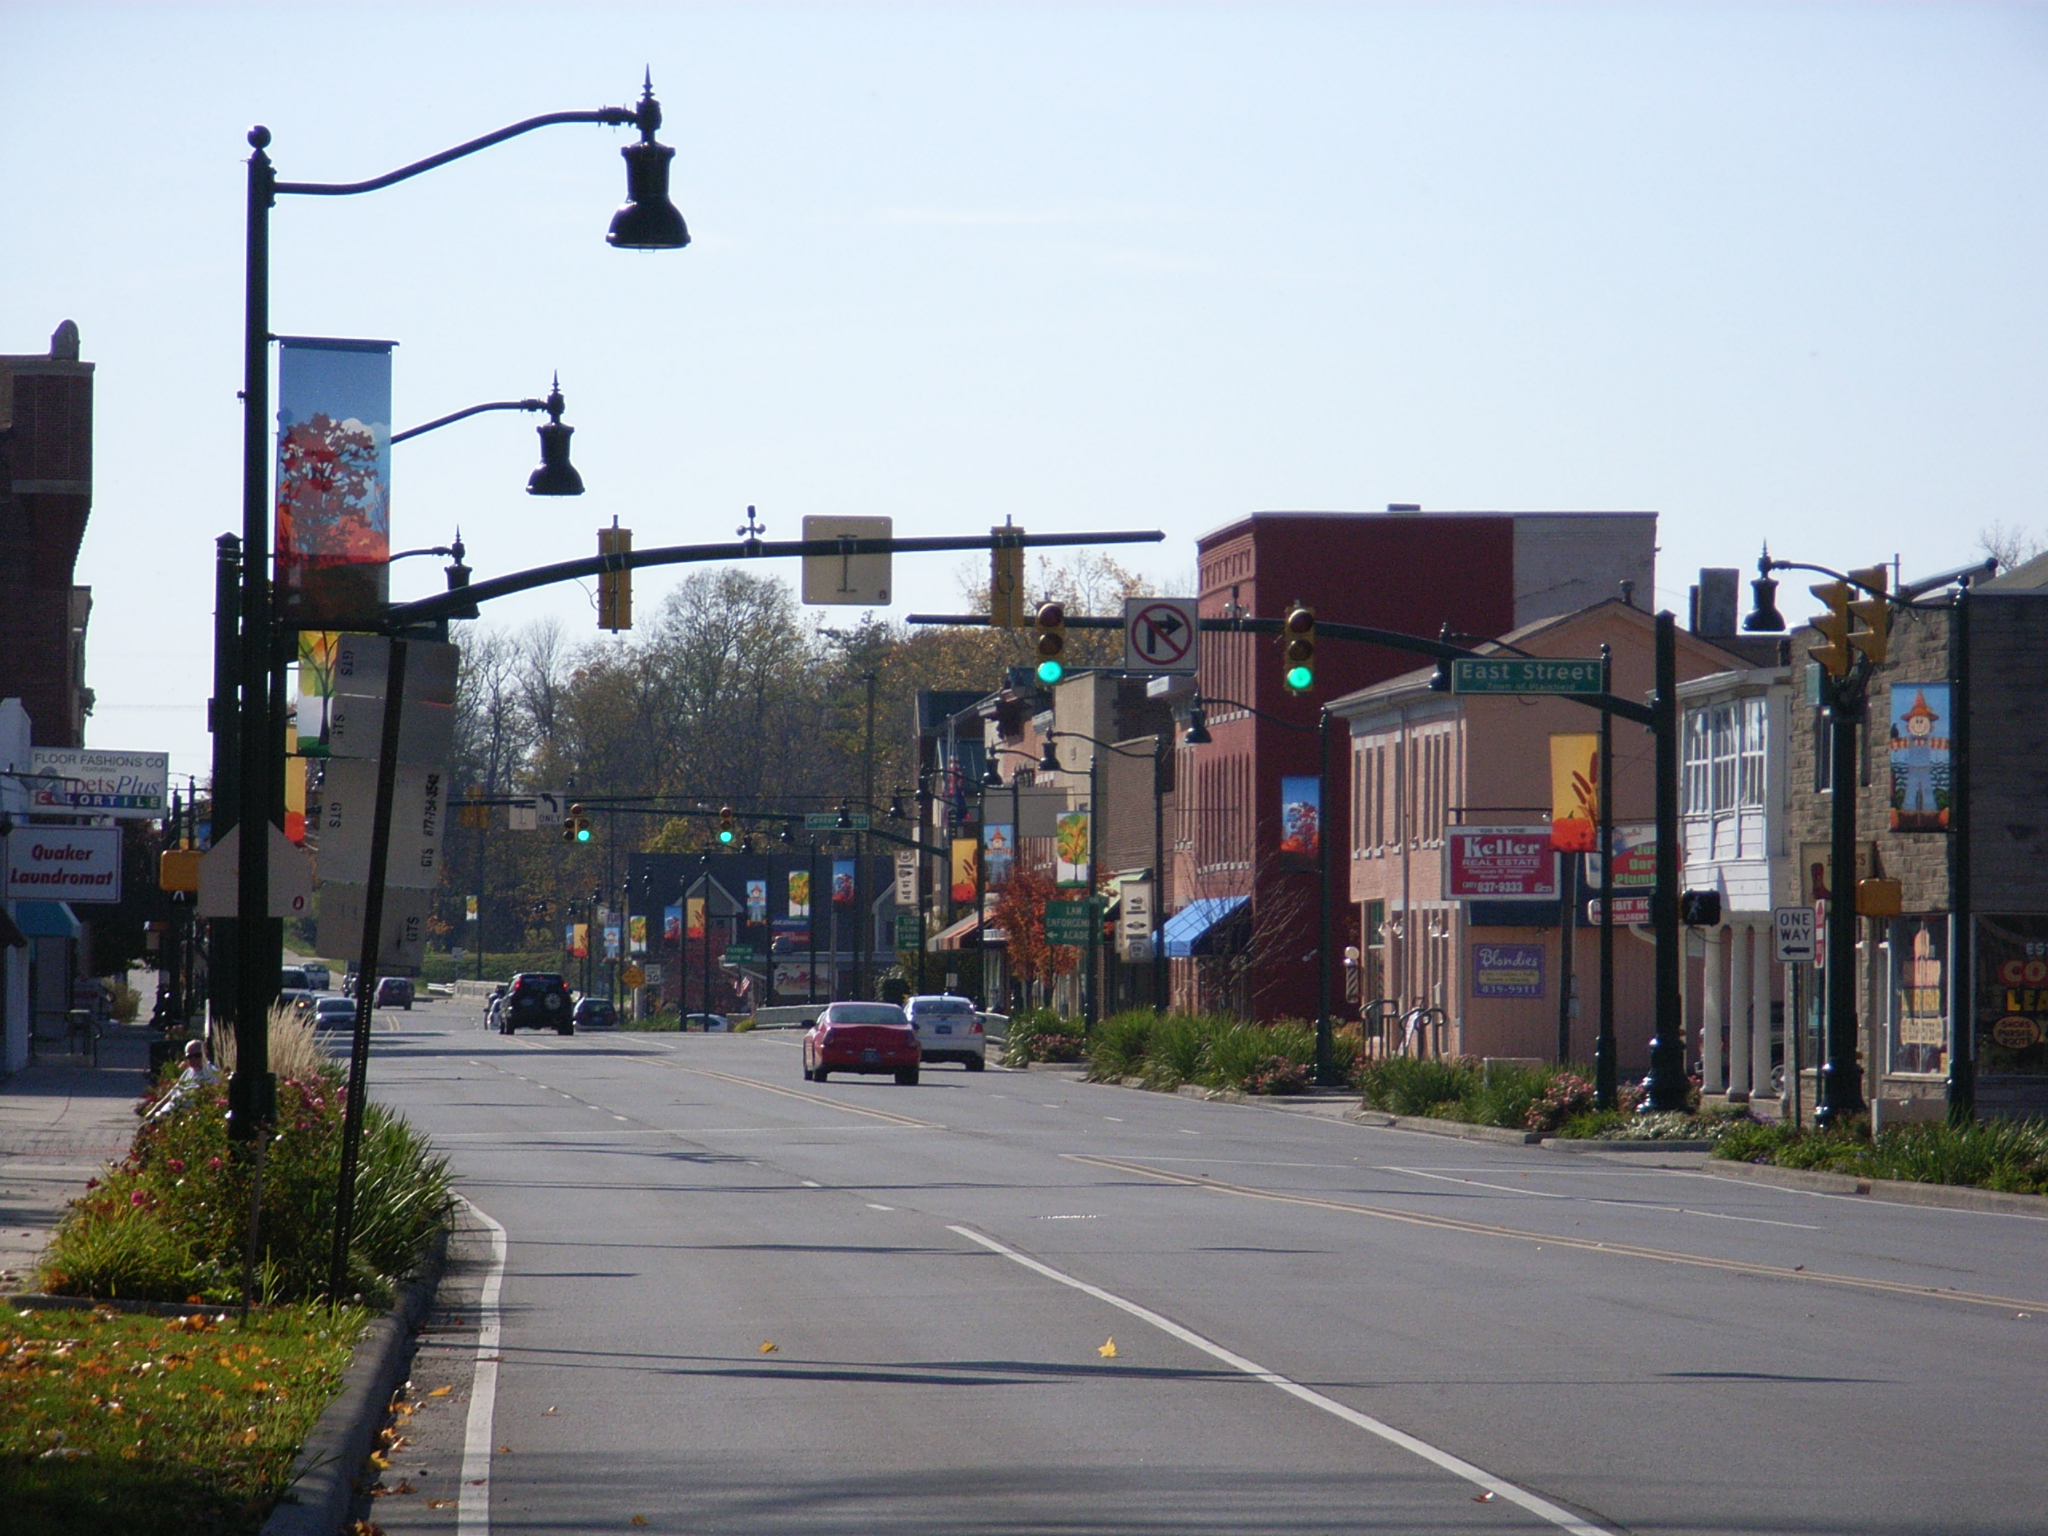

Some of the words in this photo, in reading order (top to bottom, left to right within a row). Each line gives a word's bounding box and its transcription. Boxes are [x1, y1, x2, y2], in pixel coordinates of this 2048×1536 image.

[1462, 663, 1510, 680] East
[1523, 663, 1595, 680] Street
[34, 753, 77, 765] FLOOR
[80, 754, 143, 768] FASHIONS
[145, 757, 164, 768] CO
[38, 793, 158, 807] CLORTILE
[329, 802, 342, 828] GTS
[538, 813, 561, 824] ONLY
[807, 816, 836, 825] Center
[31, 843, 94, 861] Quaker
[1463, 836, 1540, 858] Keller
[1497, 858, 1540, 866] ESTATE
[10, 867, 113, 886] Laundromat
[1614, 872, 1657, 885] Plumb
[1066, 906, 1082, 915] LAW
[1593, 900, 1632, 910] RBIT
[1046, 918, 1101, 927] ENFORCEMT
[1780, 913, 1811, 926] ONE
[407, 916, 420, 942] GTS
[1063, 930, 1101, 940] ACADEY
[1780, 928, 1811, 941] WAY
[1479, 948, 1539, 967] Blondies
[646, 974, 660, 983] 30
